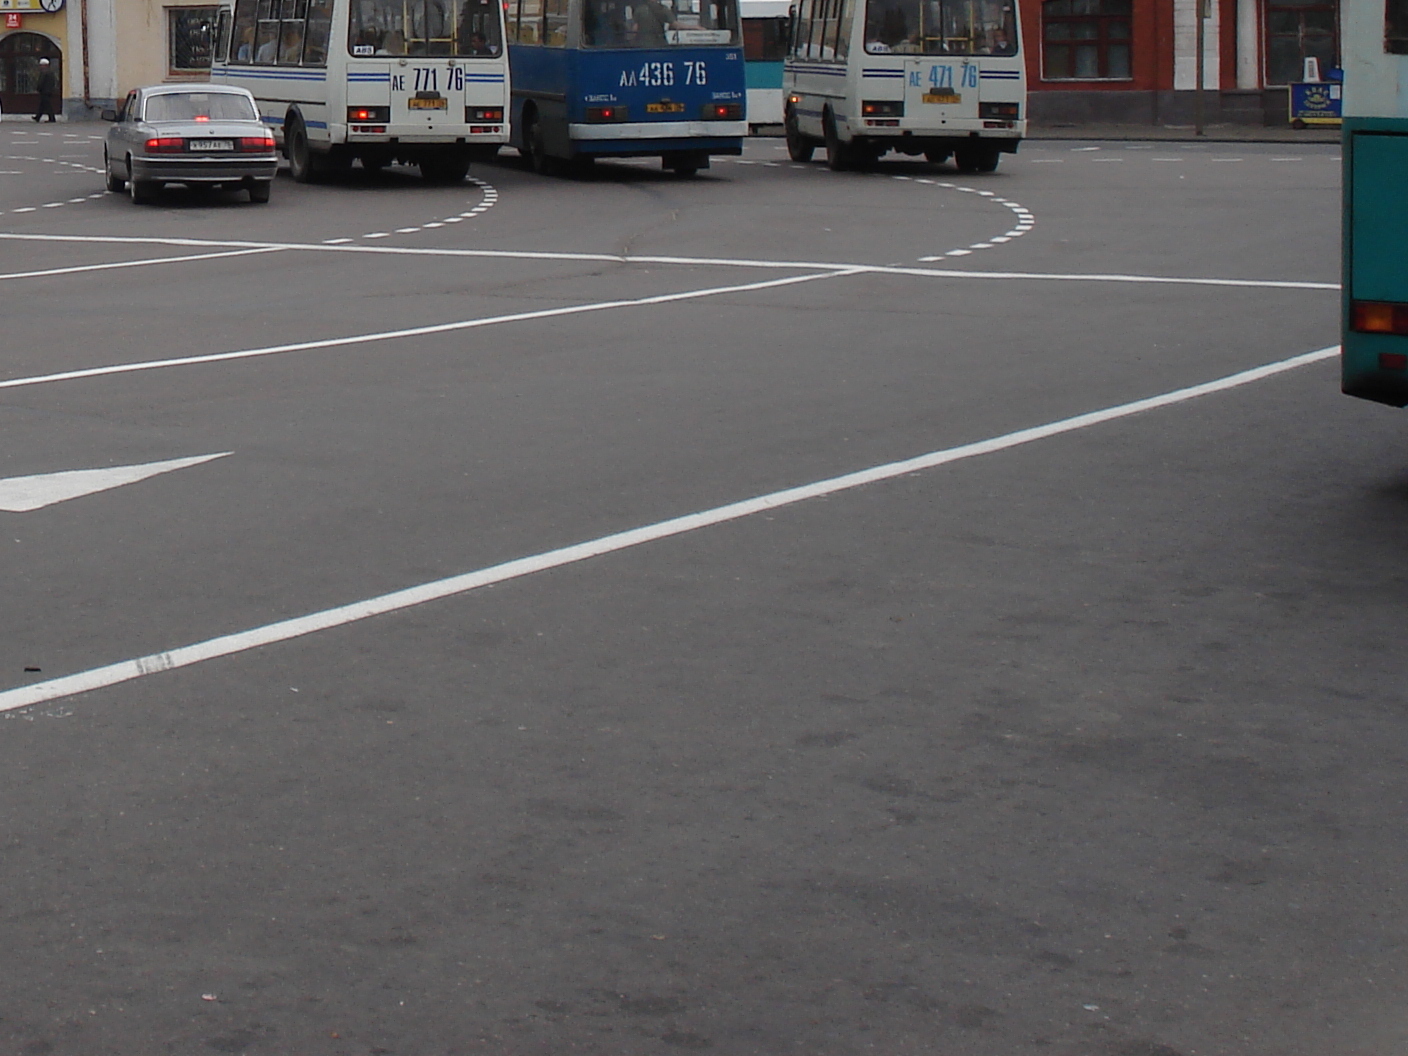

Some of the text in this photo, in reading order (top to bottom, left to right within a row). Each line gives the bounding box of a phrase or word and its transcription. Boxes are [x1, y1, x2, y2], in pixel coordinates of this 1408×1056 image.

[413, 68, 437, 91] 771
[446, 68, 463, 91] 76
[639, 62, 674, 86] 436
[684, 61, 706, 85] 76
[928, 65, 953, 88] 471
[961, 65, 977, 88] 76
